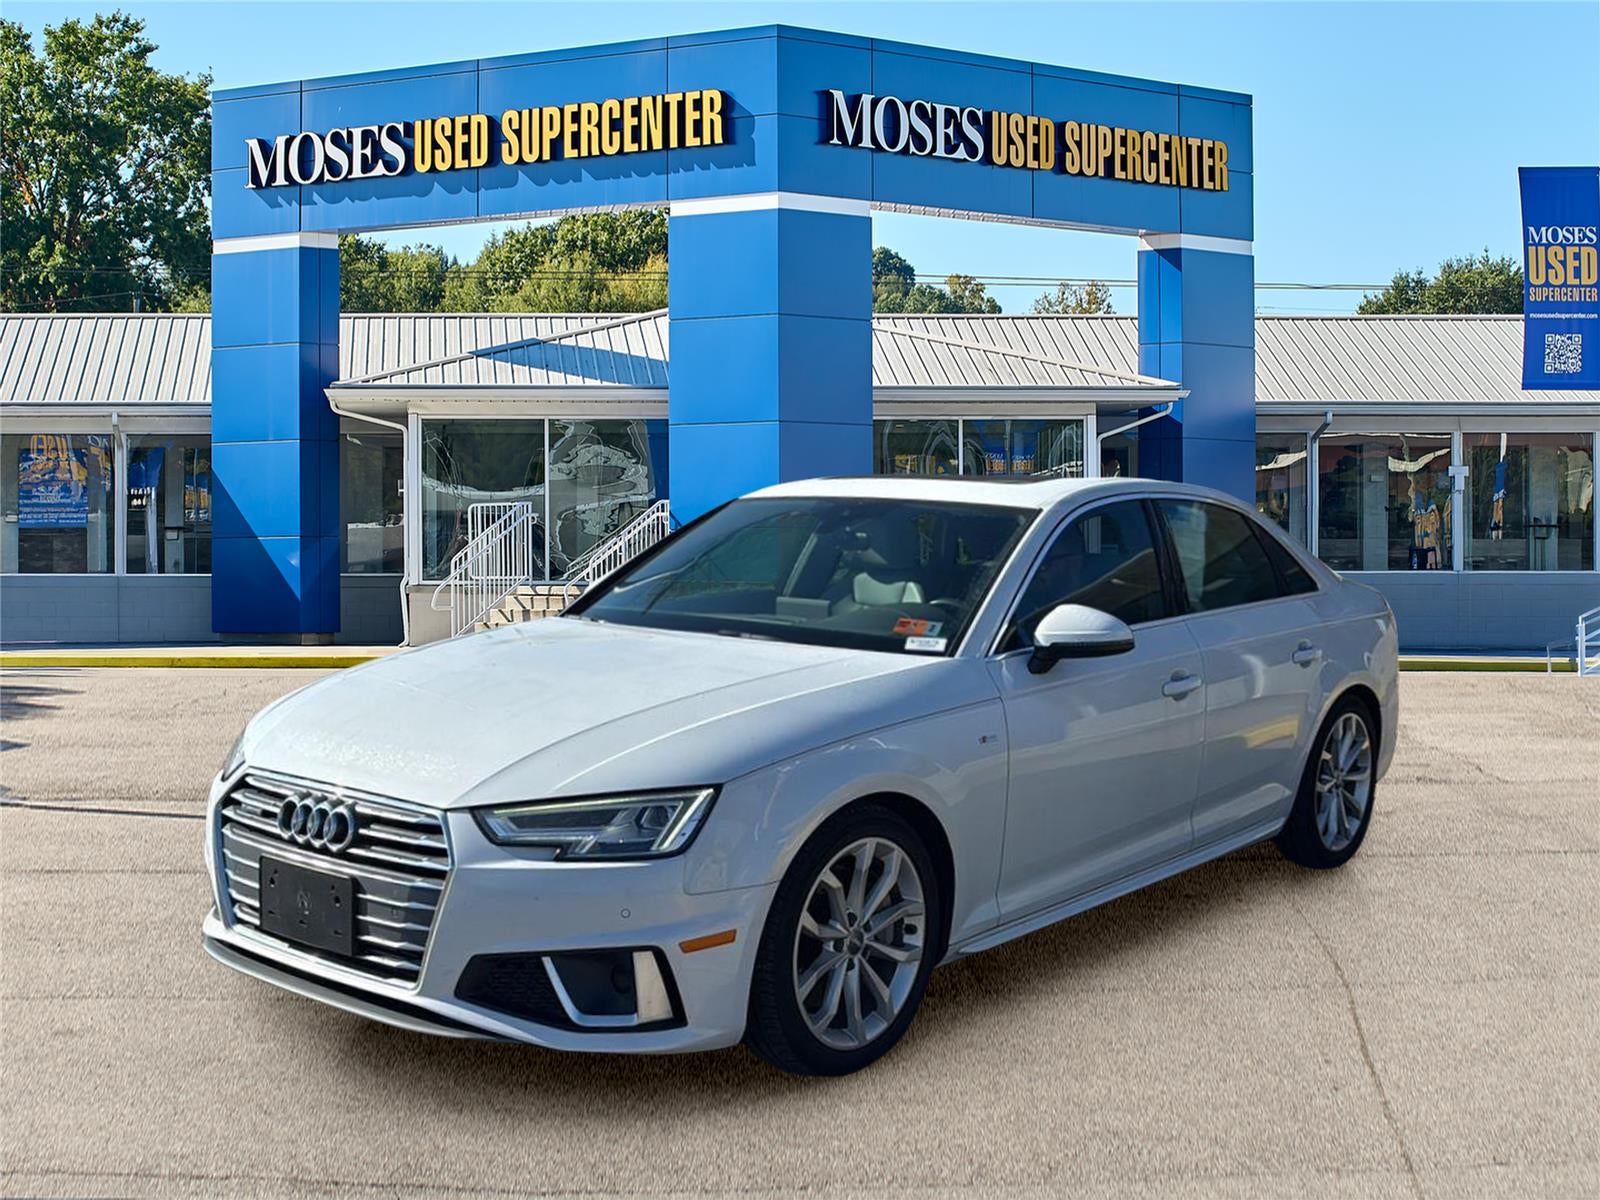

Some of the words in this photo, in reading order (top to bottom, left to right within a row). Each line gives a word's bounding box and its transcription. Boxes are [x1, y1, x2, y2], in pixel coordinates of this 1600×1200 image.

[244, 122, 406, 190] MOSES
[413, 113, 489, 173] USED
[501, 88, 724, 164] SUPERCENTER
[828, 88, 985, 162] MOSES
[991, 110, 1056, 170] USED
[1065, 119, 1230, 192] SUPERCENTER
[1527, 226, 1597, 244] MOSES
[1528, 246, 1598, 286] USED
[1529, 287, 1598, 302] SUPERCENTER
